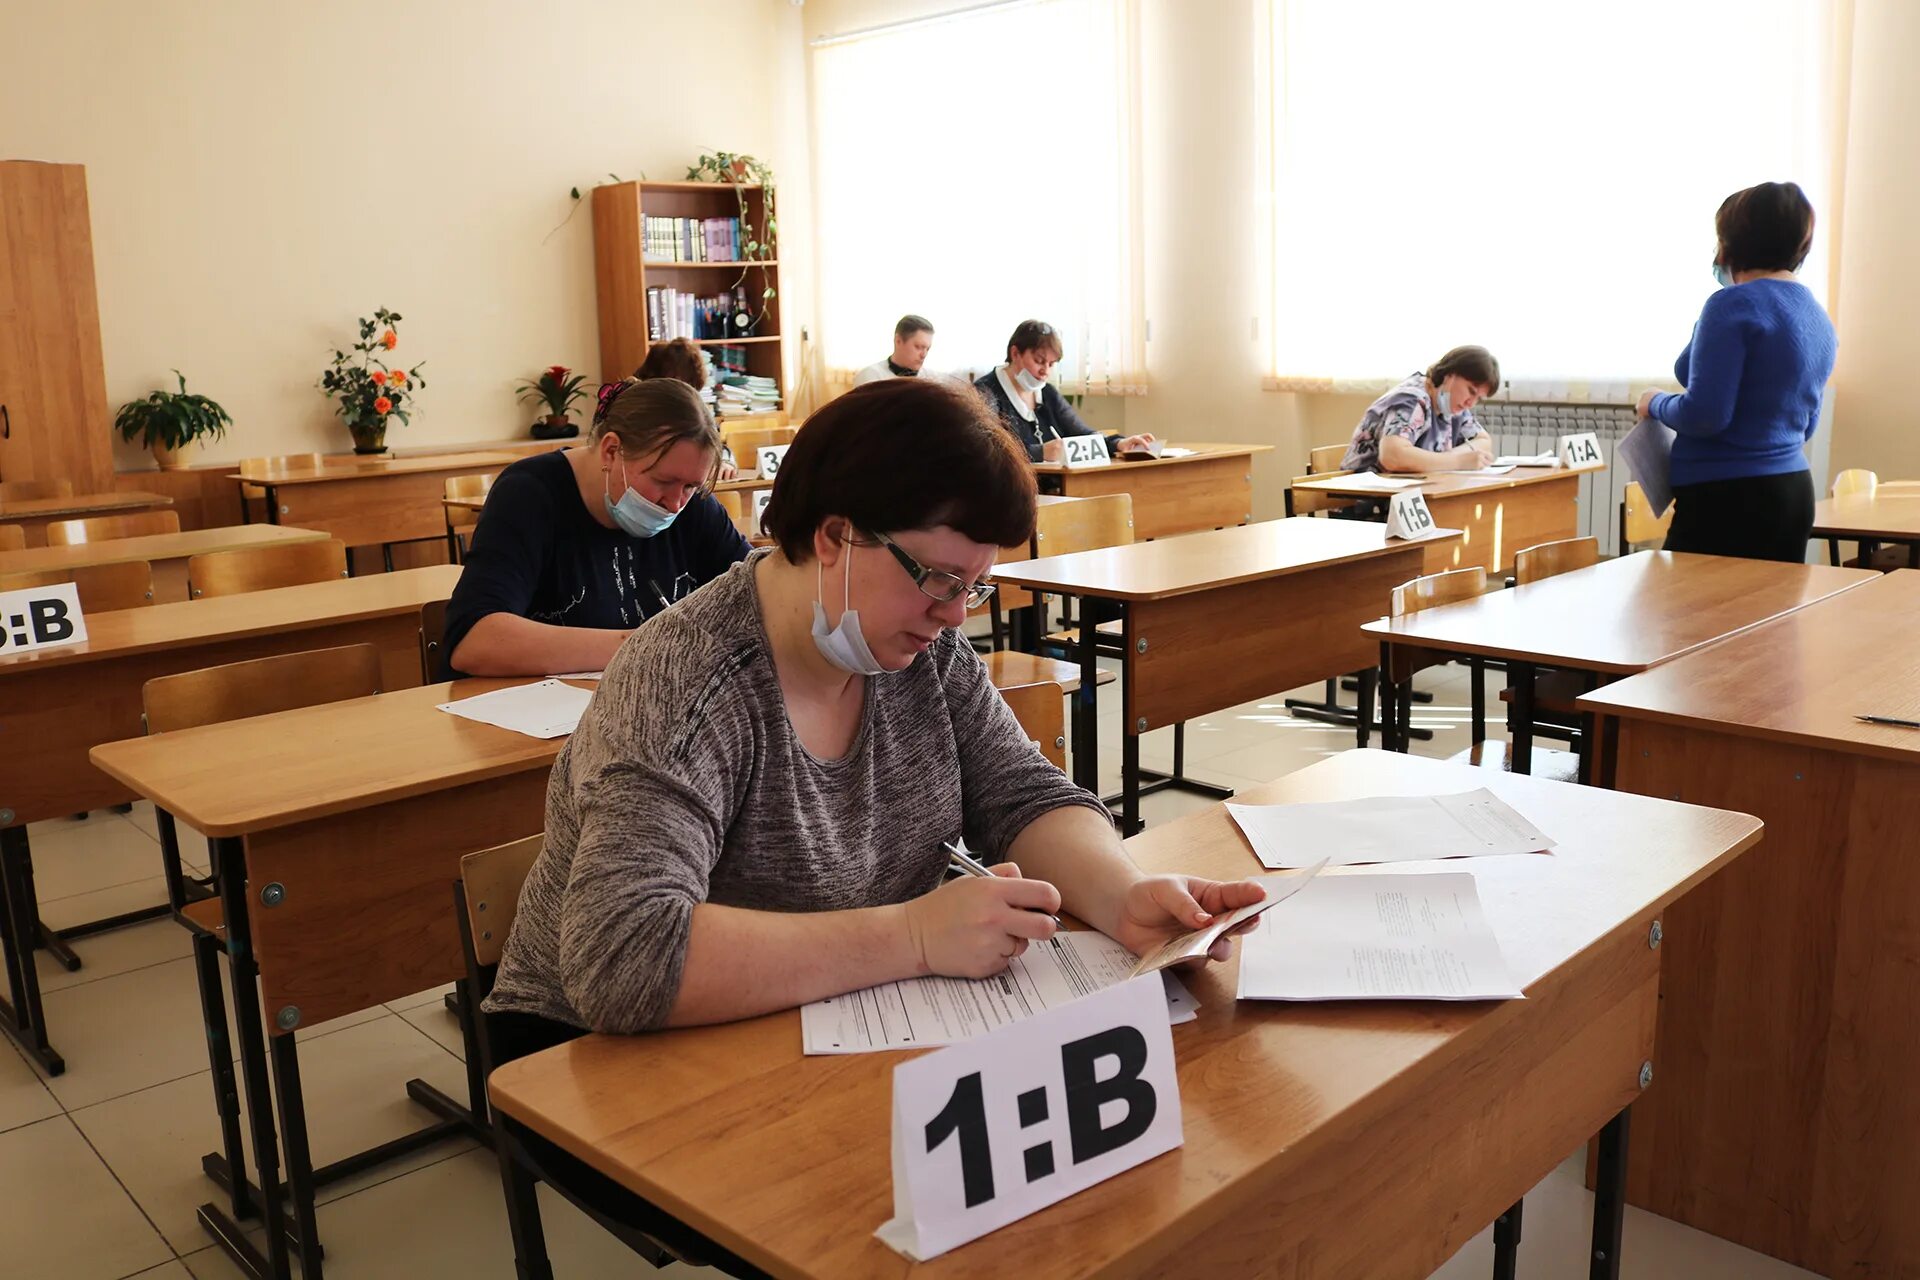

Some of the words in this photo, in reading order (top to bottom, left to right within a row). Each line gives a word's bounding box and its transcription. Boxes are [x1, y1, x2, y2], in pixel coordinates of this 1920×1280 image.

[1067, 439, 1106, 462] 2:А
[1567, 440, 1598, 462] 1:А
[1399, 496, 1430, 532] 1:Б
[0, 598, 74, 649] :В
[924, 1025, 1158, 1209] 1:В
